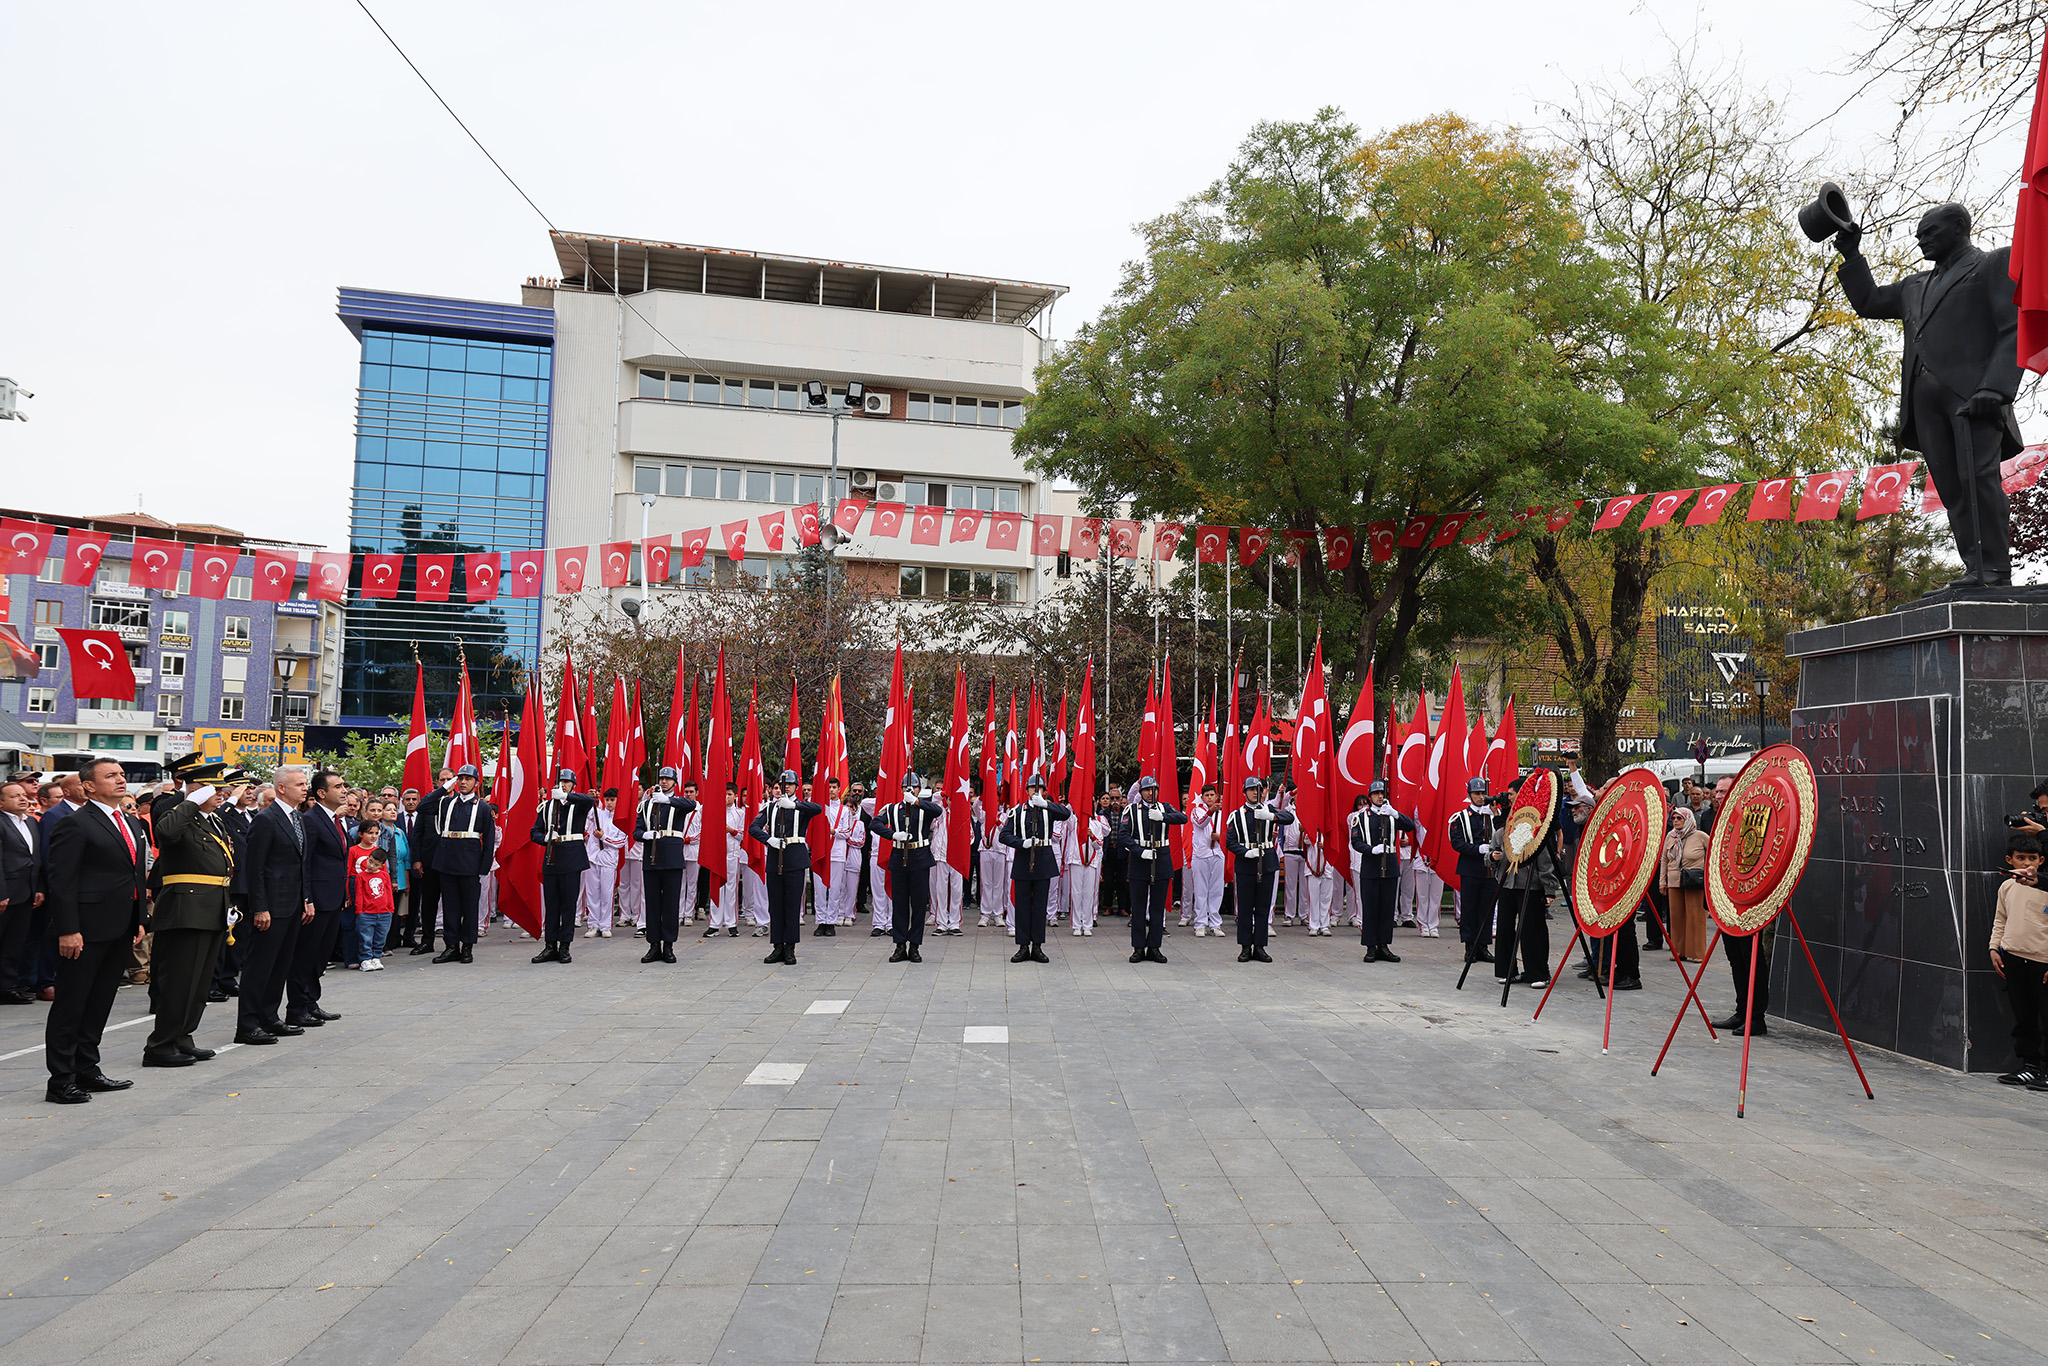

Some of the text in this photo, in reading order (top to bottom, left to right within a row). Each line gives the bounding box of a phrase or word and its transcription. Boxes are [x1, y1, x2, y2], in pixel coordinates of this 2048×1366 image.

[222, 639, 251, 647] AVUKAT
[231, 732, 276, 743] ERCAN
[1798, 721, 1839, 740] TÜRK
[238, 744, 297, 754] AKSESUAR
[1820, 754, 1868, 774] ÖĞÜN
[1740, 784, 1786, 813] KARAMAN
[1840, 795, 1886, 816] ÇALIŞ
[1600, 808, 1641, 842] KARAMAN
[1867, 831, 1928, 854] GÜVEN
